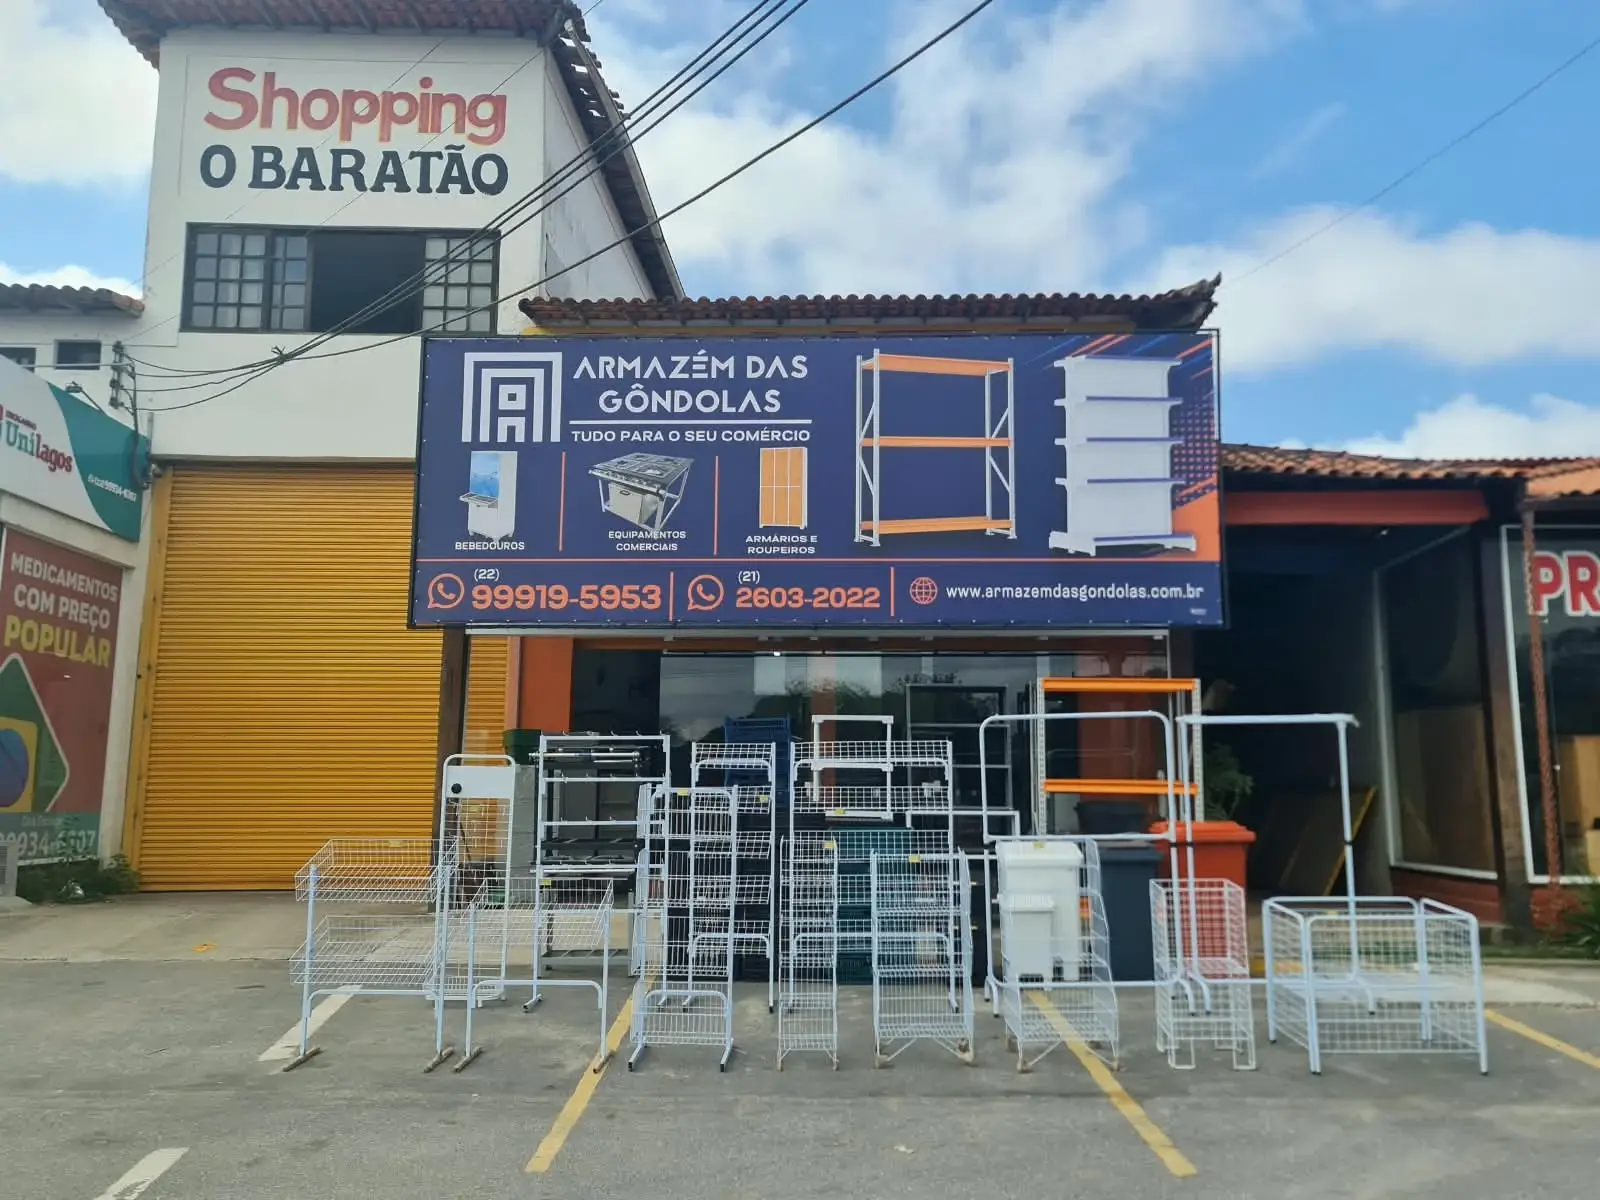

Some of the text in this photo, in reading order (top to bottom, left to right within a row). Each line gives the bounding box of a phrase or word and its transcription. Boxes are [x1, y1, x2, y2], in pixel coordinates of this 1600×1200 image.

[204, 67, 507, 145] Shopping
[201, 144, 508, 195] O BARATÃO
[573, 349, 808, 379] ARMAZÉM DAS
[598, 383, 781, 413] GÔNDOLAS
[572, 427, 810, 442] TUDO PARA O SEU COMÉRCIO
[6, 420, 73, 473] Unilagos
[608, 530, 687, 540] EQUIPAMENTOS
[745, 534, 806, 543] ARMÁRIOS
[455, 541, 525, 551] BEBEDOUROS
[615, 542, 678, 551] COMERCIAIS
[747, 546, 815, 554] ROUPEIROS
[11, 551, 118, 602] MEDICAMENTOS
[473, 568, 500, 582] (22)
[738, 571, 760, 584] (21)
[471, 584, 661, 610] 99919-5953
[736, 587, 880, 608] 2603-2022
[946, 583, 1204, 601] www.armazemdasgondolas.com.br
[14, 584, 111, 633] COM PREÇO
[3, 614, 111, 668] POPULAR
